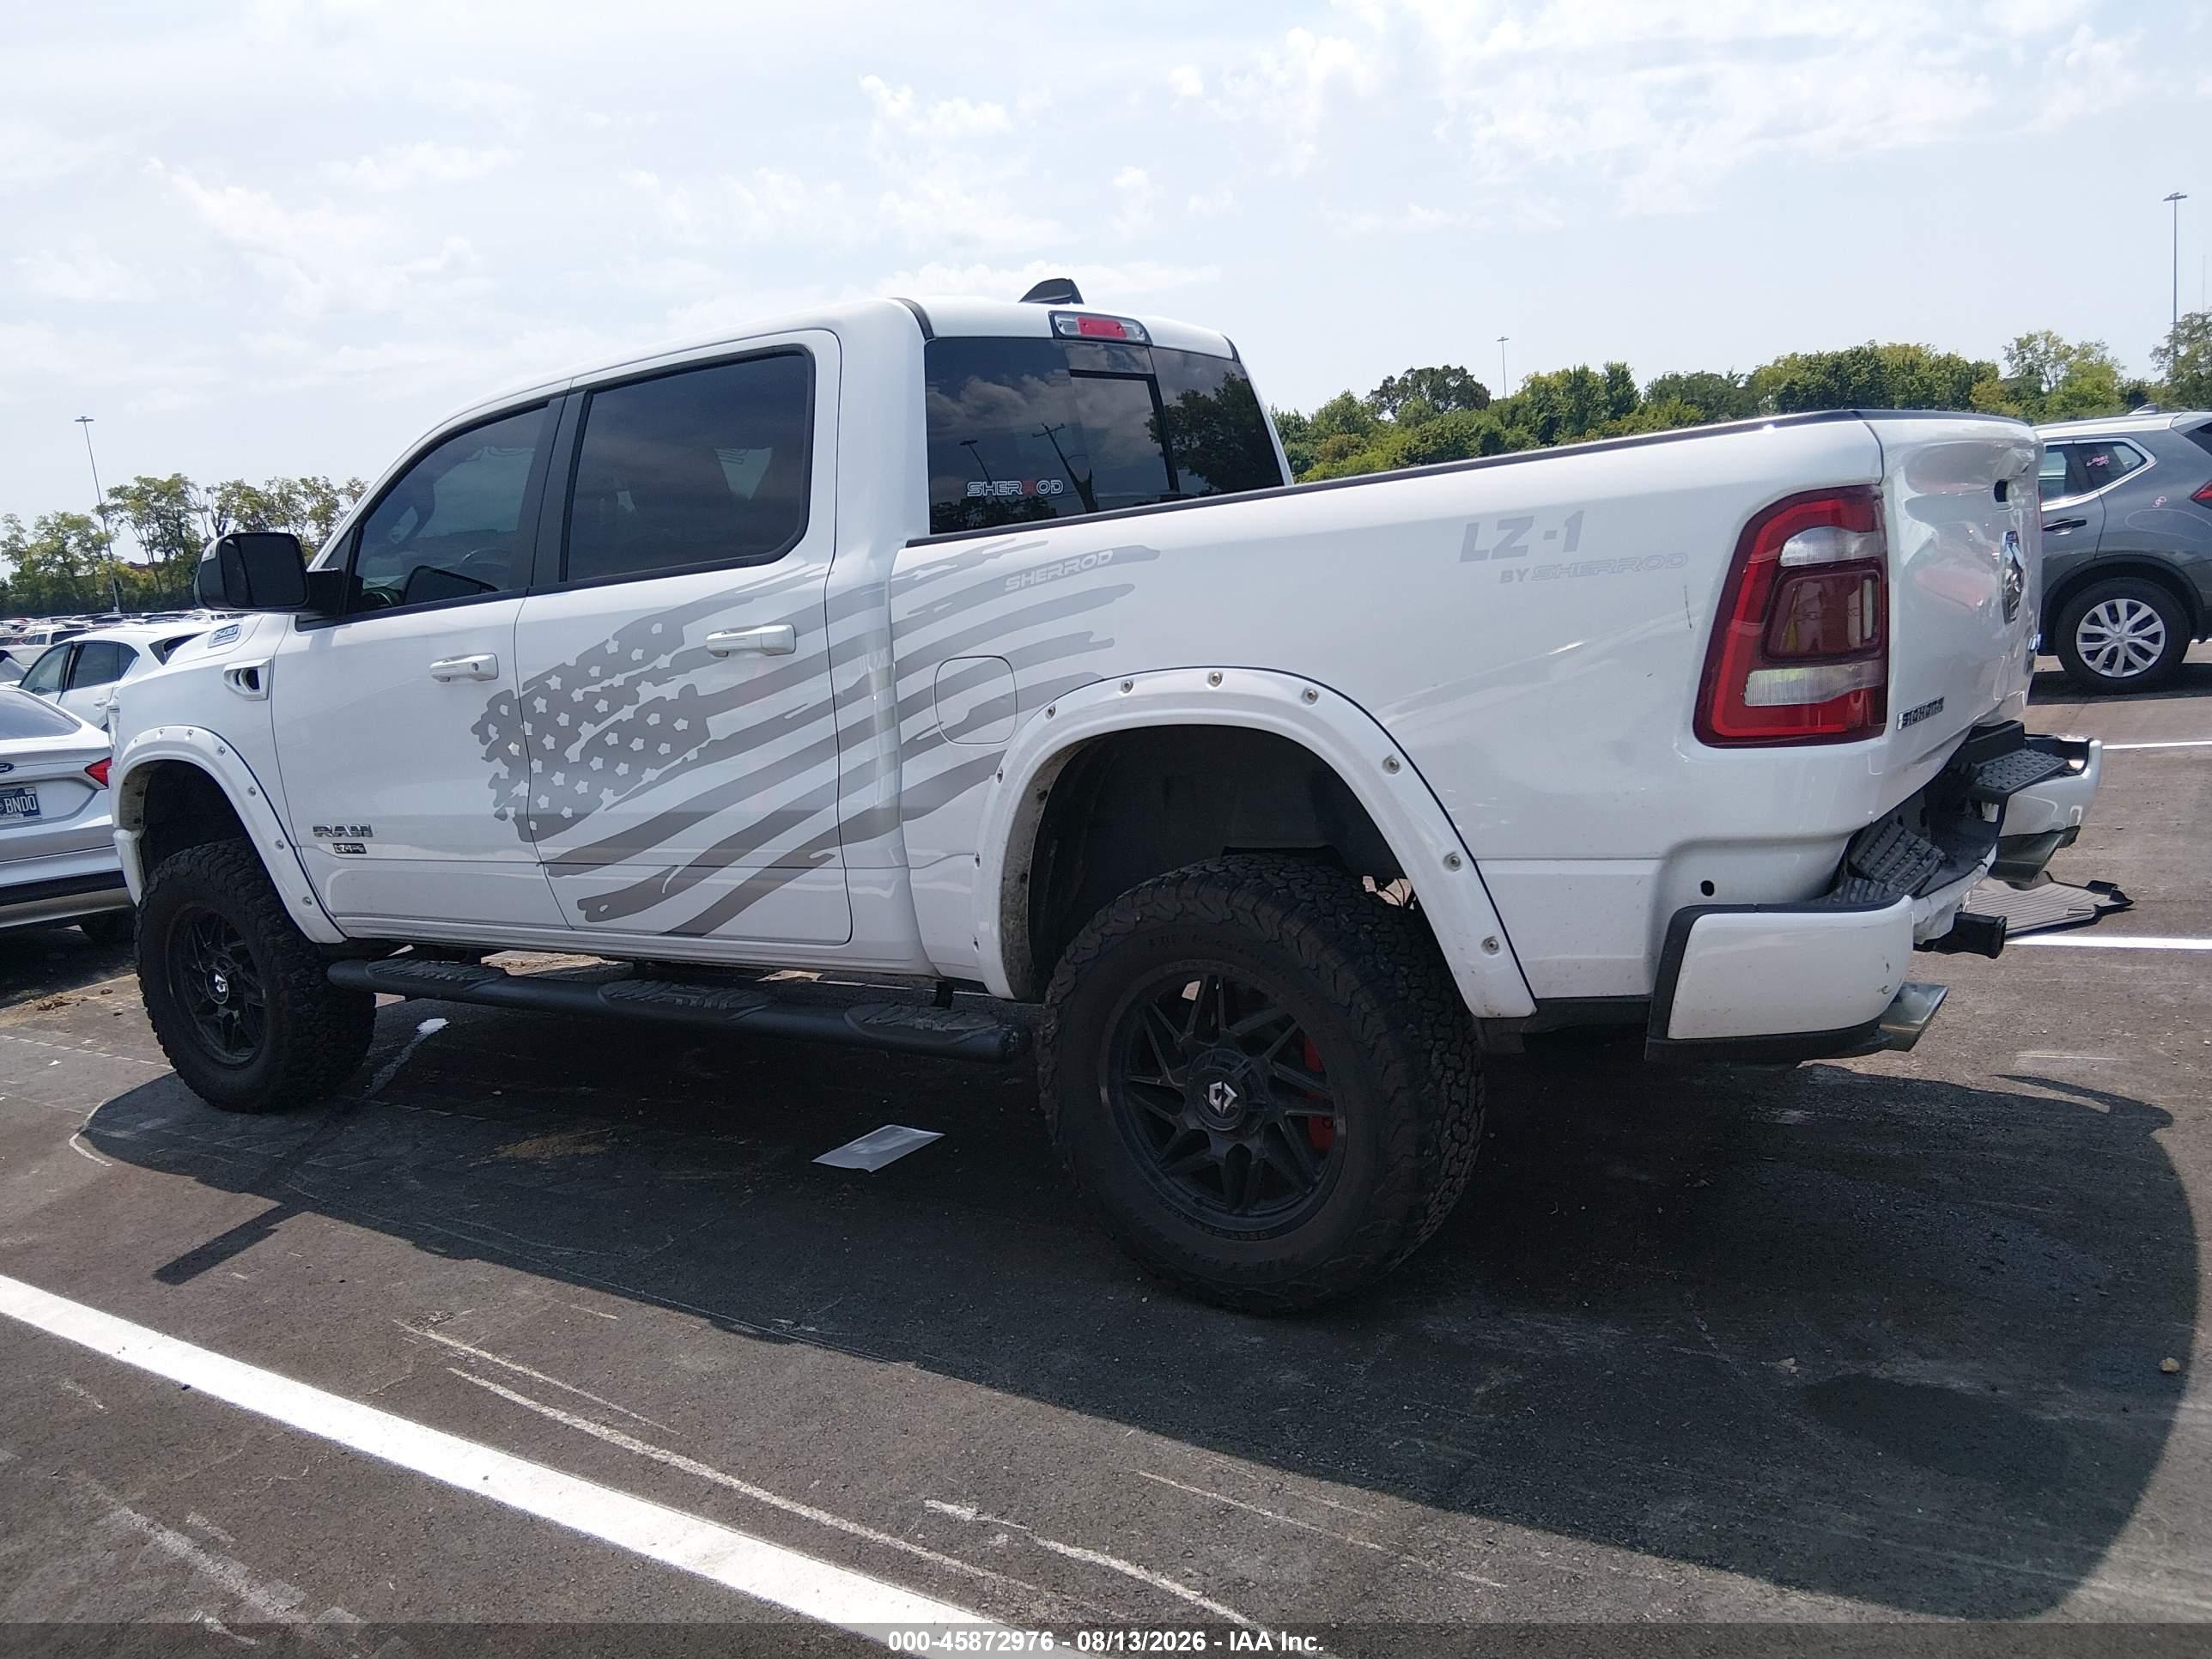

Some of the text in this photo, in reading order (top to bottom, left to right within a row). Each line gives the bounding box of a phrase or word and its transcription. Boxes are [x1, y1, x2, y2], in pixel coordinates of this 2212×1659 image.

[1460, 510, 1584, 563] LZ-1
[1005, 550, 1114, 592] SHERROD
[1499, 553, 1688, 584] BY SHERROD
[313, 824, 374, 837] RAM
